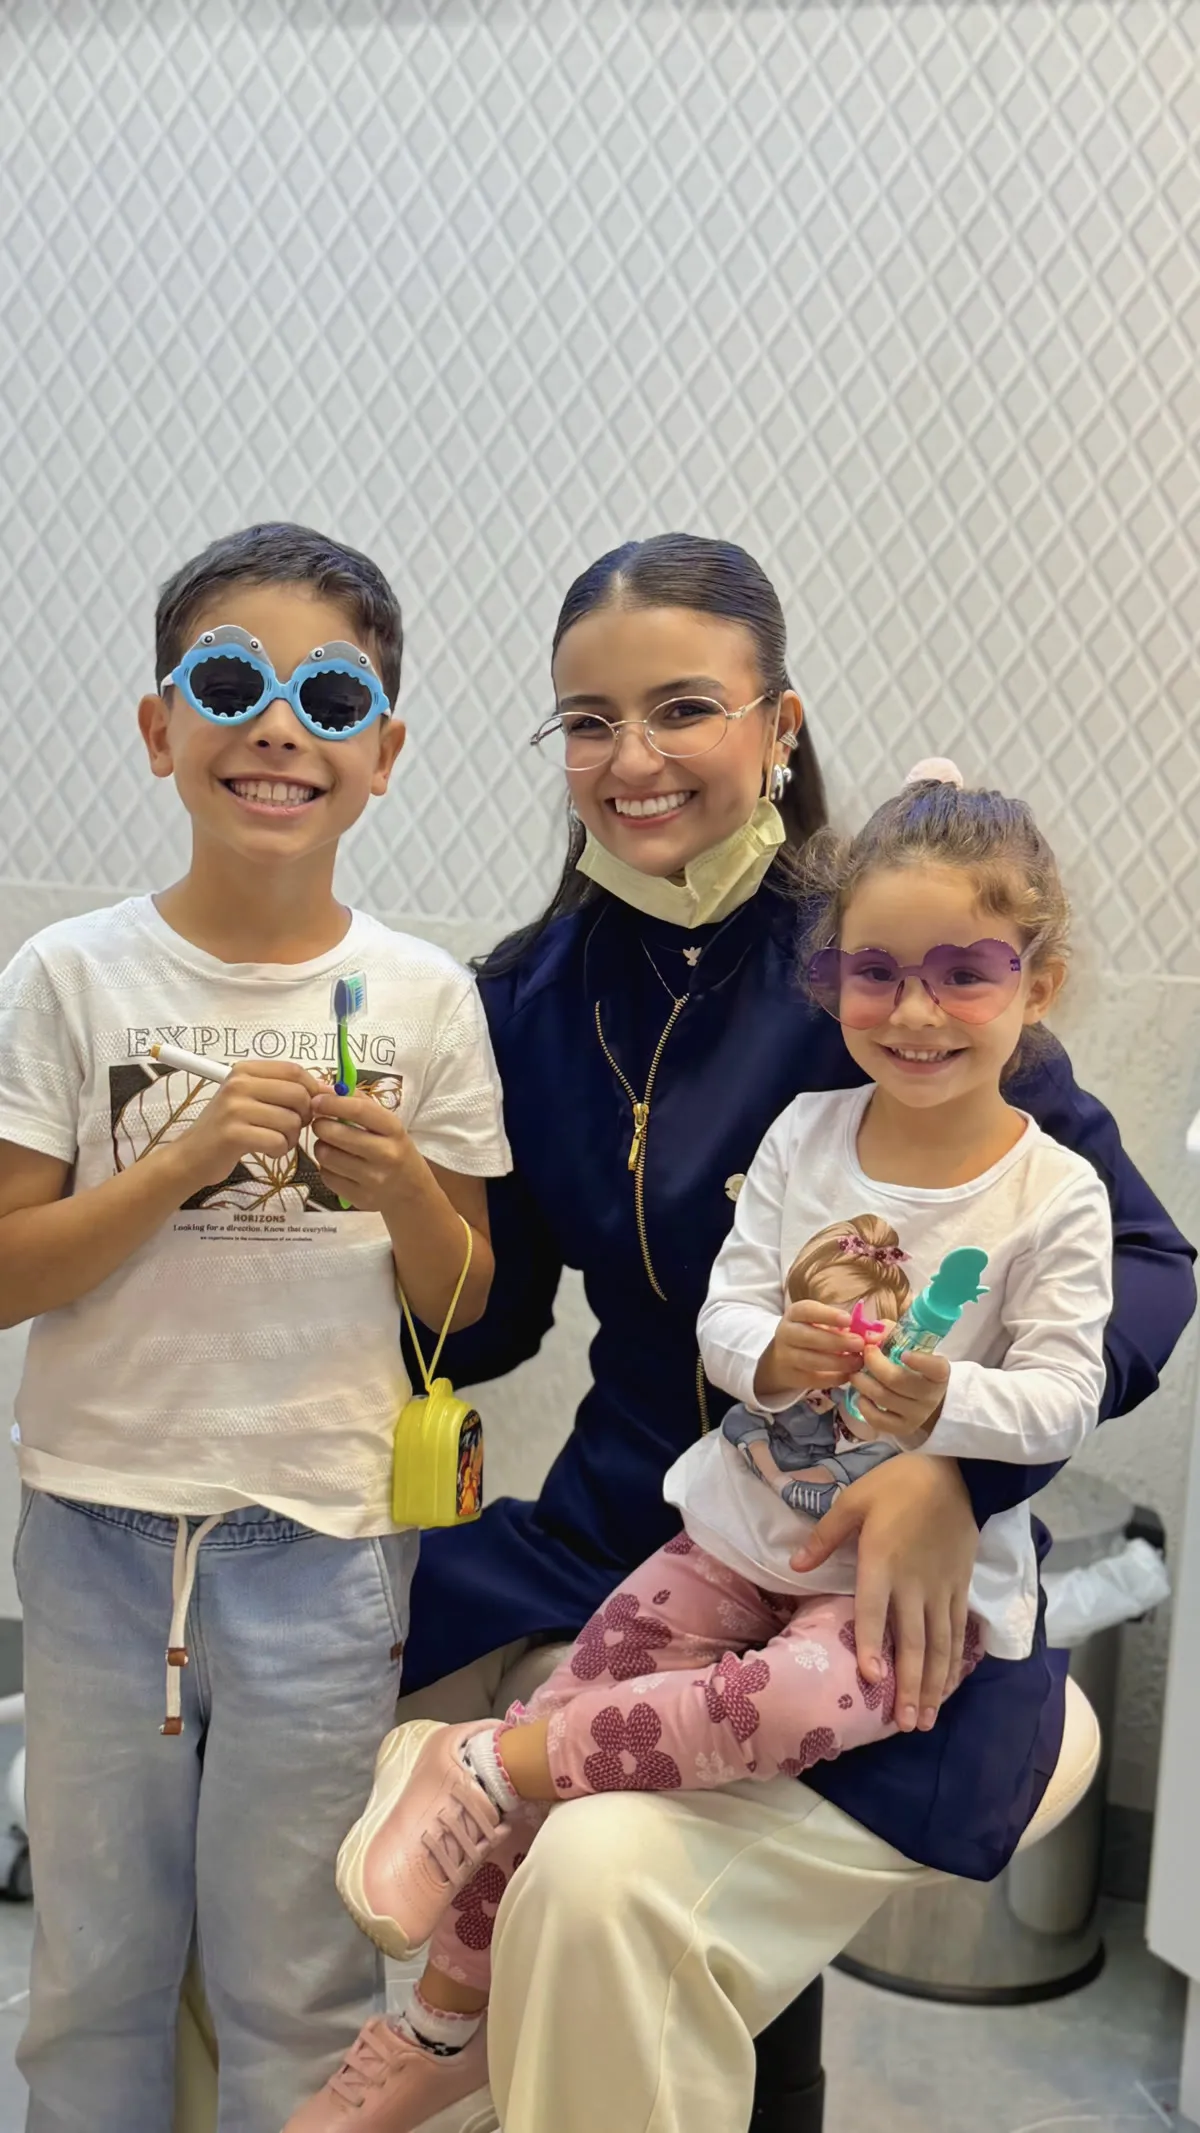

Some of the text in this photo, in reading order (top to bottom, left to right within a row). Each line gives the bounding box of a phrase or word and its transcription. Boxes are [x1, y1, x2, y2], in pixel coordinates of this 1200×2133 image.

[127, 1026, 396, 1066] EXPLORING
[233, 1214, 286, 1223] HORIZONS
[173, 1224, 205, 1232] Looking
[287, 1225, 301, 1233] that
[302, 1226, 338, 1234] everything
